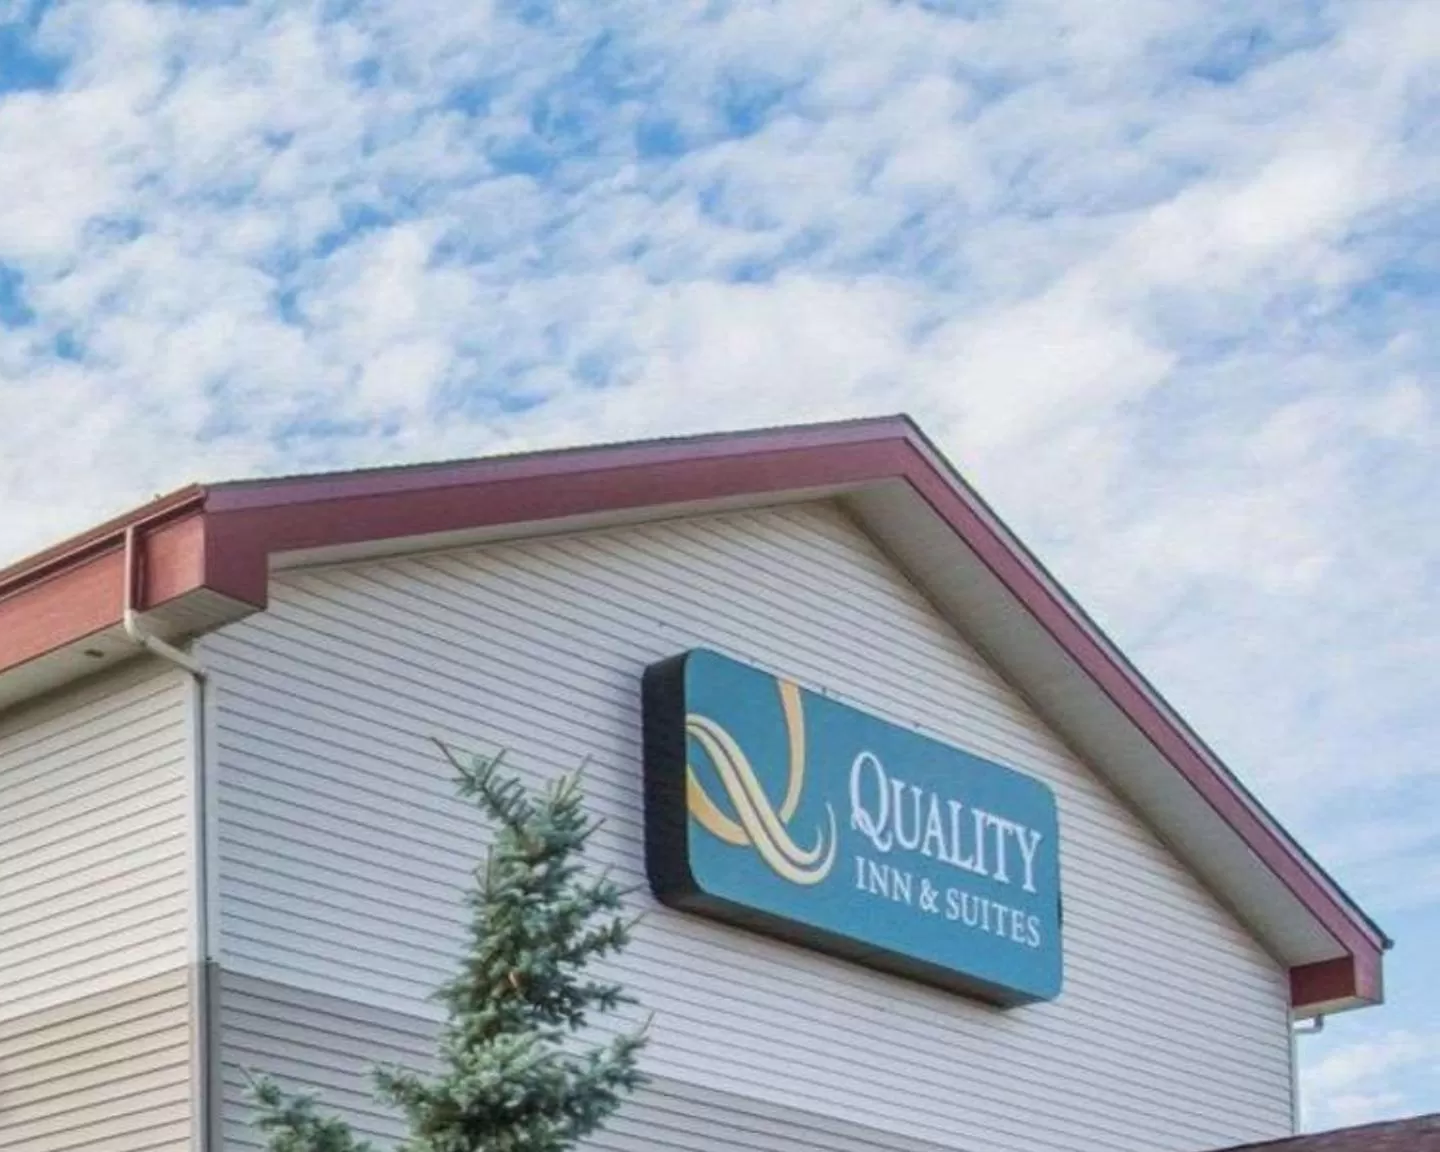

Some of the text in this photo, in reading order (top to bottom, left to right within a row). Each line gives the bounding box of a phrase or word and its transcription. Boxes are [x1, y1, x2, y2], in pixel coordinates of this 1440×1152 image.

[850, 751, 1043, 893] QUALITY
[854, 855, 1041, 948] INN & SUITES
